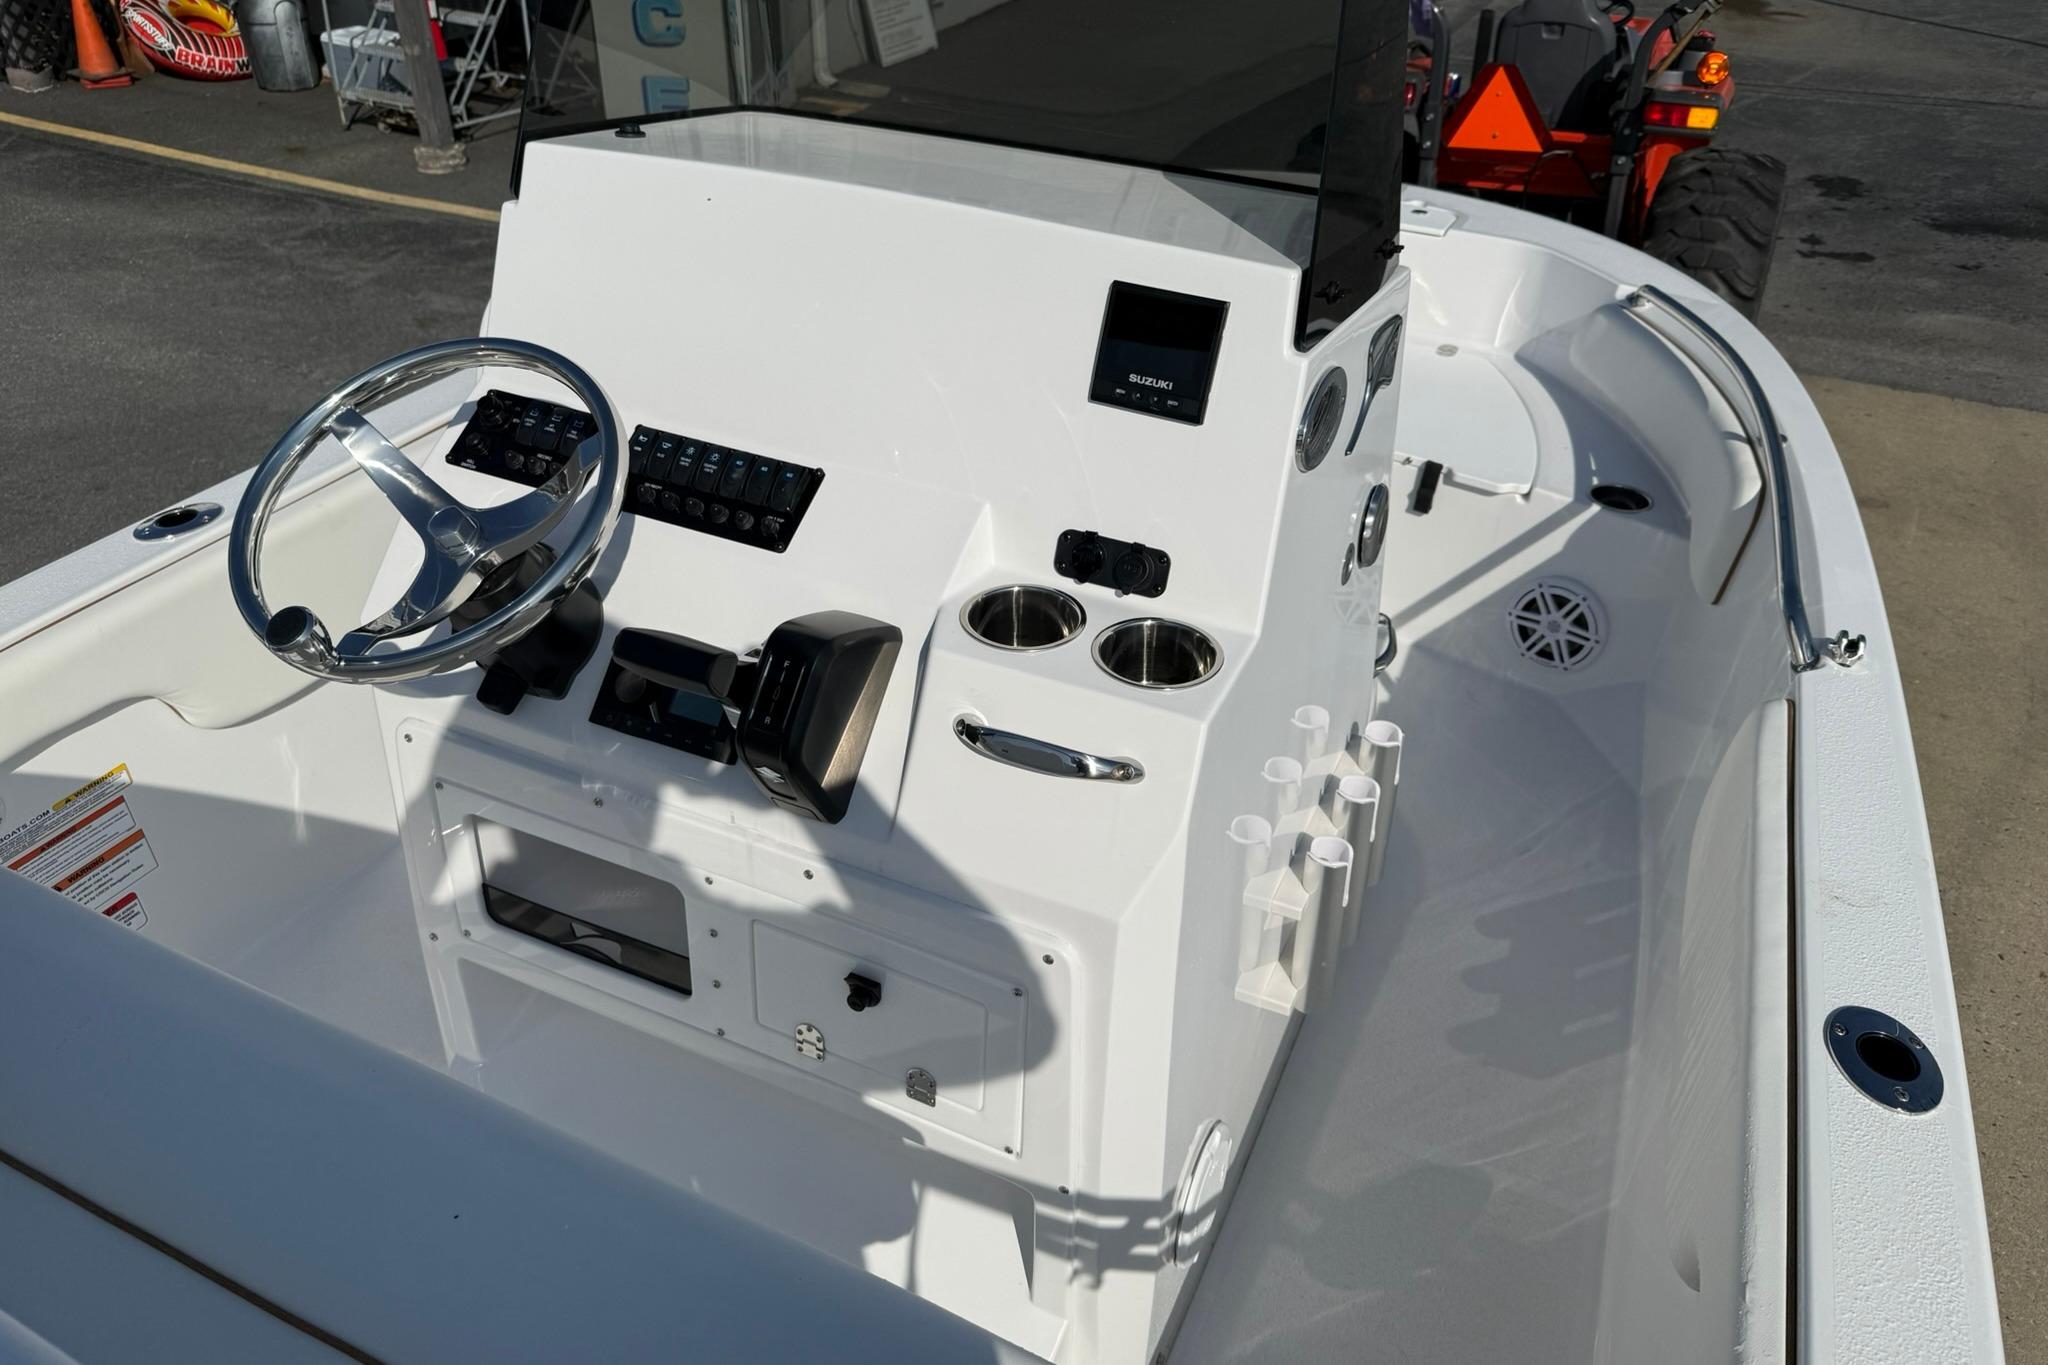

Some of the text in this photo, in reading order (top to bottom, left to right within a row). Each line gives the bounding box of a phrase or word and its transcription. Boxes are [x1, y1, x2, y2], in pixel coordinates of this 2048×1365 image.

[1128, 373, 1173, 391] SUZUKI
[73, 771, 114, 798] WARNING
[67, 856, 105, 884] WARNING
